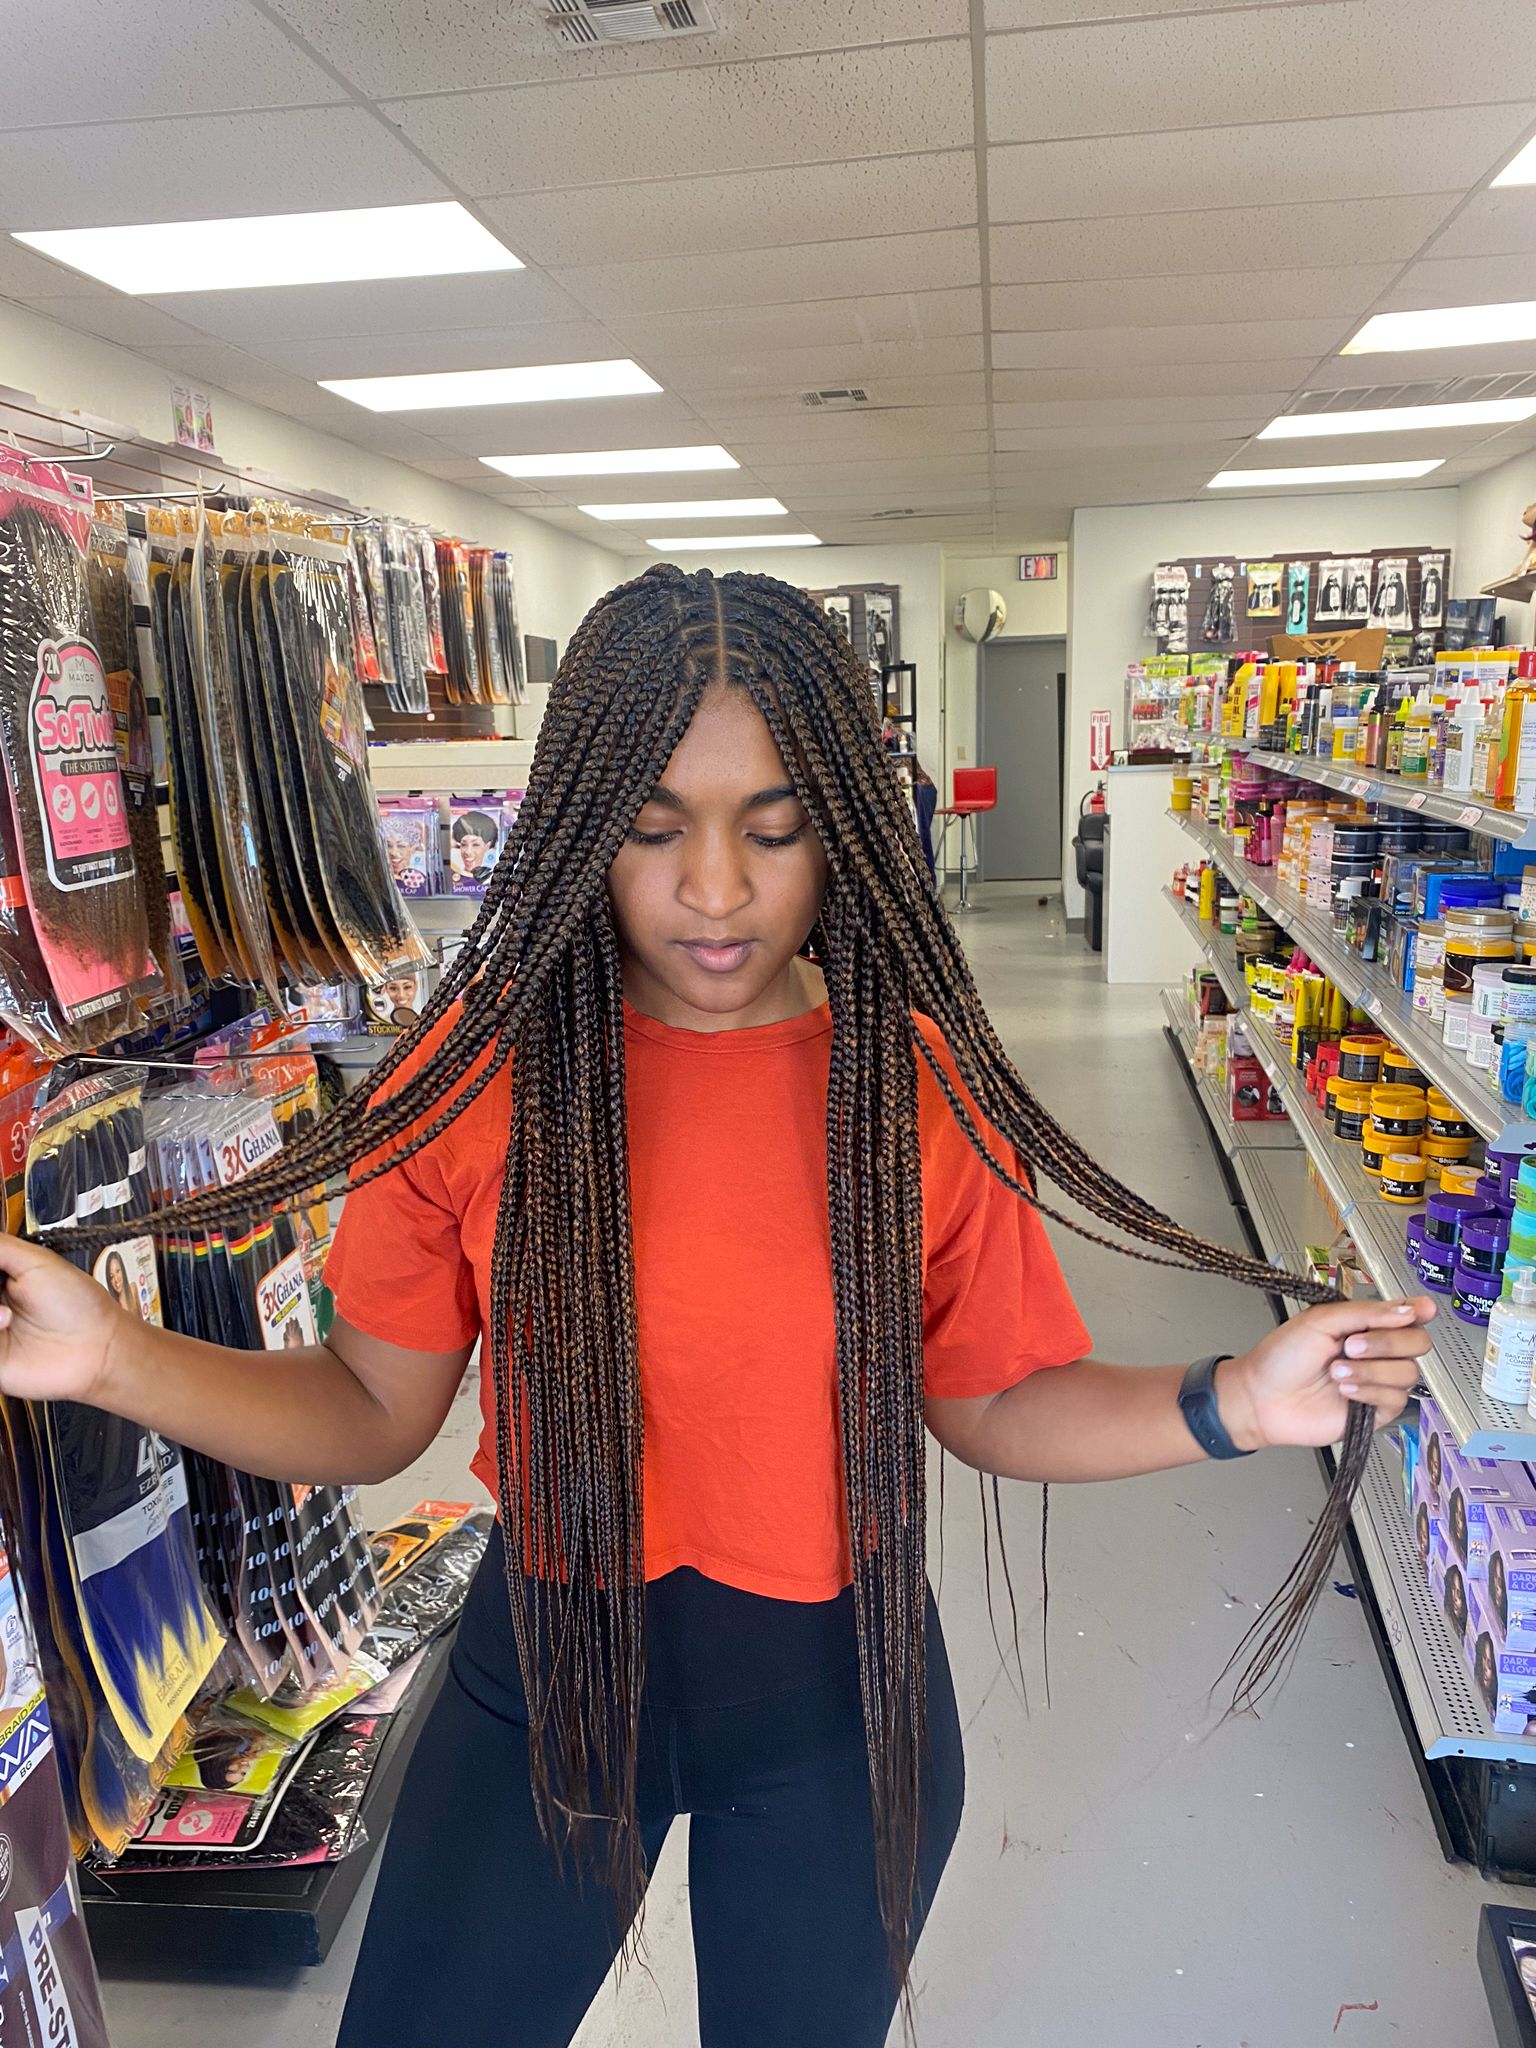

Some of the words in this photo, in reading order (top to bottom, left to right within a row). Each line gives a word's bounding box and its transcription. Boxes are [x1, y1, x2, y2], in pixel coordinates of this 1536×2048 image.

[1024, 556, 1056, 577] EXIT
[44, 653, 60, 674] 2X
[68, 673, 94, 682] MAYDE
[1092, 715, 1109, 723] FIRE
[453, 885, 475, 893] SHOWER
[11, 1121, 30, 1162] 3
[222, 1135, 248, 1182] 3X
[243, 1128, 279, 1163] GHANA
[1421, 1259, 1440, 1272] Shine
[1427, 1269, 1445, 1280] Jam
[263, 1282, 279, 1322] 3X
[277, 1271, 304, 1305] GHANA
[1467, 1294, 1493, 1307] Shine
[296, 1522, 320, 1557] 100%
[302, 1556, 329, 1591] 100%
[313, 1590, 338, 1623] 100%
[1502, 1665, 1510, 1673] &
[1503, 1656, 1529, 1666] DARK
[20, 1760, 33, 1778] BG
